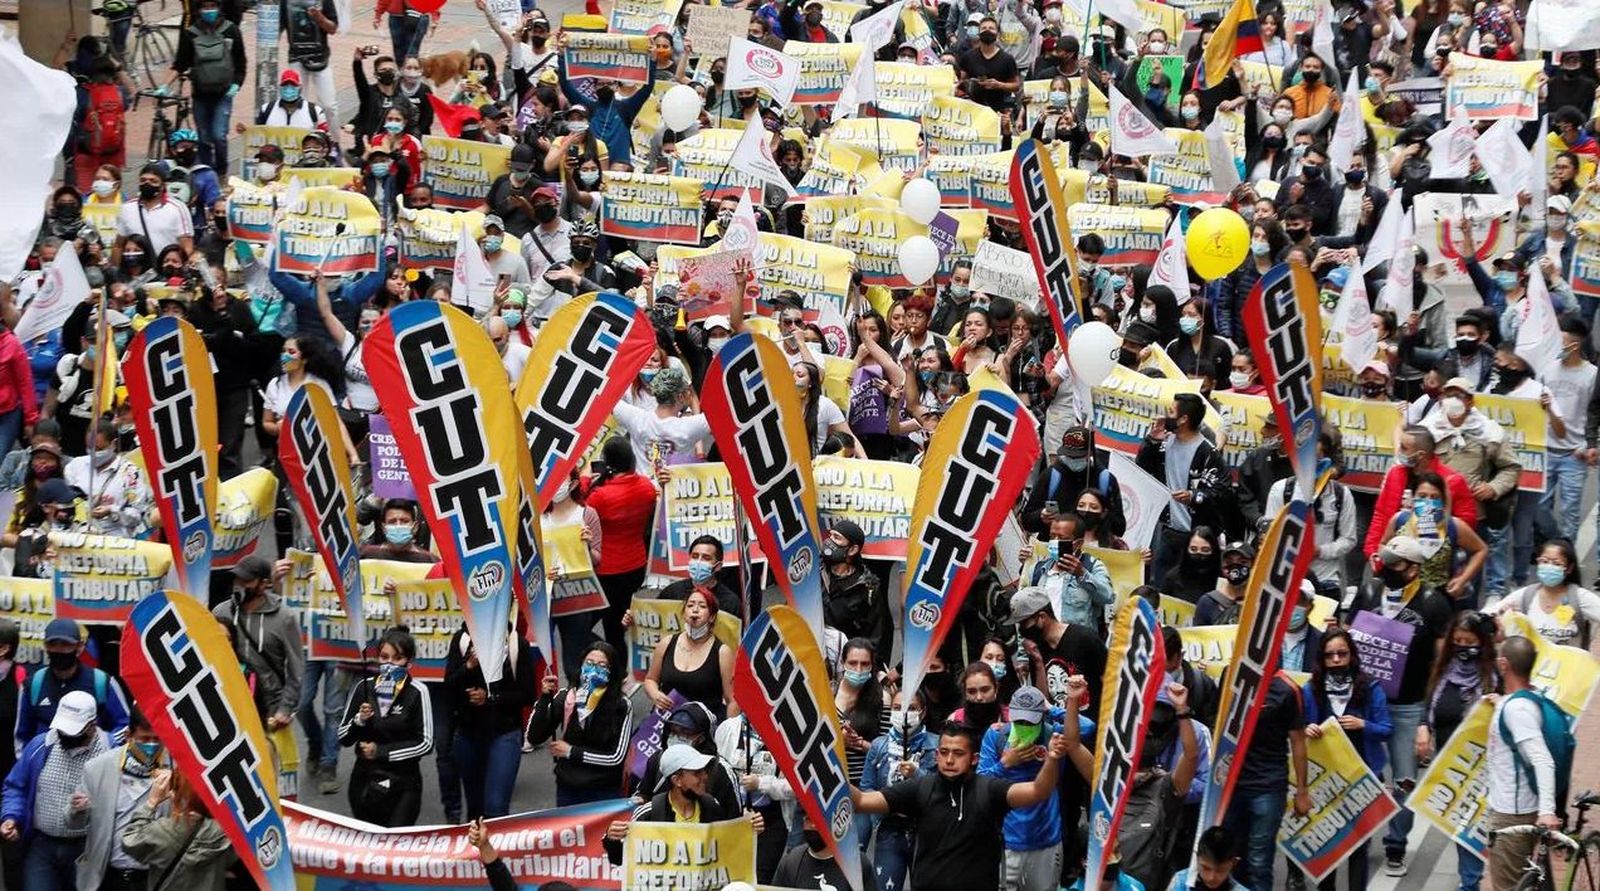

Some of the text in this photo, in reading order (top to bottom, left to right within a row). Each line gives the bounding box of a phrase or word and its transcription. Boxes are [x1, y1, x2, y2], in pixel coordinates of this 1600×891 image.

[571, 51, 649, 69] TRIBUTARIA
[429, 146, 482, 167] NO A LA
[432, 163, 491, 184] REFORMA
[607, 184, 680, 206] REFORMA
[607, 206, 699, 230] TRIBUTARIA
[878, 221, 898, 240] LA
[1022, 148, 1076, 328] CUT
[762, 243, 819, 270] NO A LA
[1262, 277, 1314, 420] CUT
[522, 304, 634, 492] CUT
[147, 333, 206, 528] CUT
[1344, 410, 1368, 431] LA
[399, 322, 506, 557] CUT
[725, 349, 803, 555] CUT
[377, 471, 410, 481] GENT
[381, 458, 399, 469] DE
[292, 396, 353, 566] CUT
[675, 477, 702, 499] NO
[706, 476, 721, 498] A
[818, 468, 895, 492] NO A LA
[817, 491, 908, 516] REFORMA
[922, 400, 1016, 597] CUT
[61, 552, 149, 577] REFORMA
[21, 594, 35, 613] A
[399, 592, 428, 612] NO
[436, 592, 452, 613] A
[636, 612, 681, 632] NO A
[1226, 517, 1304, 745] CUT
[1209, 641, 1223, 661] A
[1348, 628, 1409, 655] RECE EL
[1372, 657, 1393, 670] LA
[144, 603, 268, 828] CUT
[753, 624, 842, 806] CUT
[1100, 613, 1153, 815] CUT
[1425, 740, 1488, 818] NO A LA
[1291, 777, 1383, 858] TRIBUTARIA
[302, 817, 451, 857] democracia
[486, 827, 555, 852] ontra
[559, 824, 586, 848] el
[292, 845, 342, 871] que
[342, 851, 363, 875] y
[363, 850, 389, 876] la
[502, 852, 624, 882] tributaria
[636, 838, 720, 865] NO A LA
